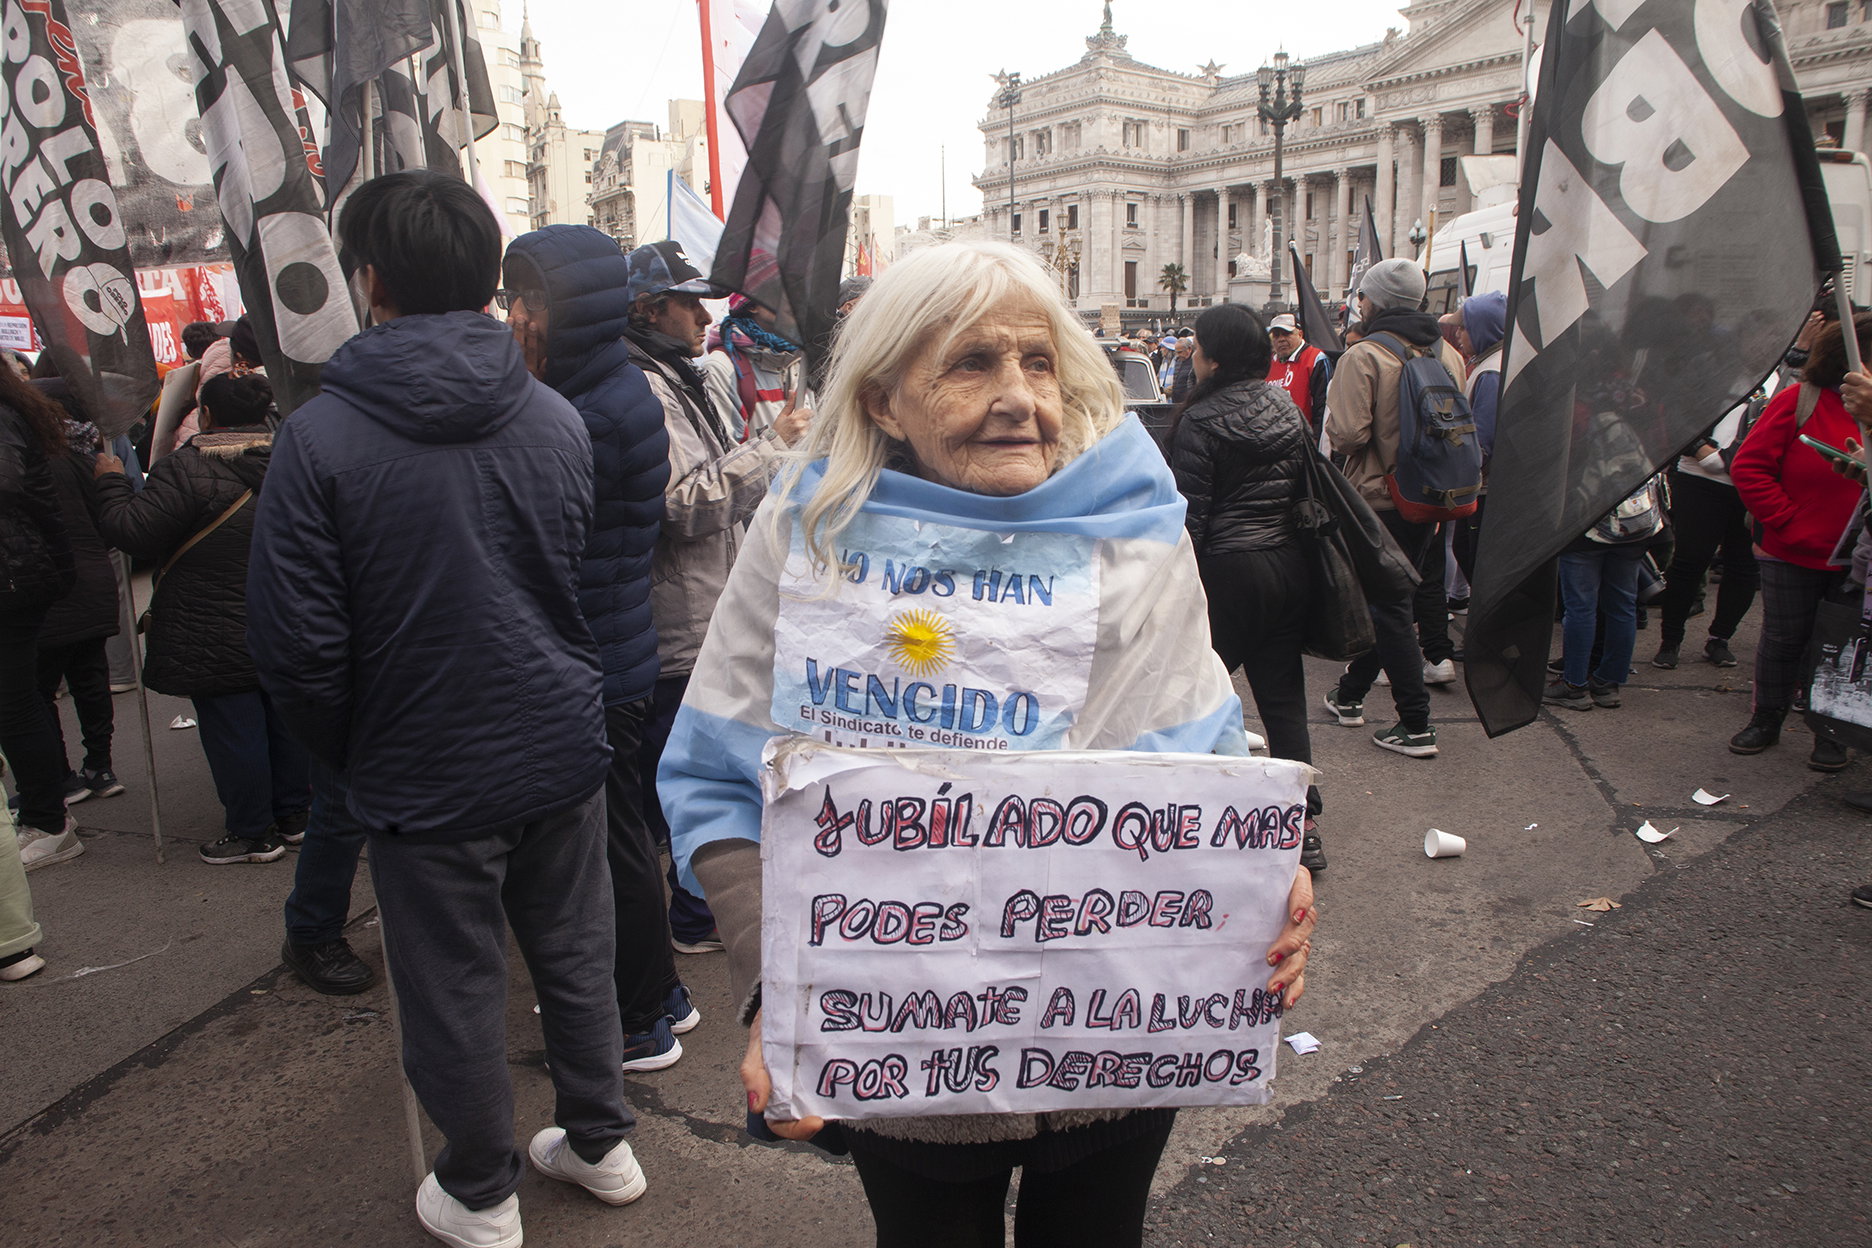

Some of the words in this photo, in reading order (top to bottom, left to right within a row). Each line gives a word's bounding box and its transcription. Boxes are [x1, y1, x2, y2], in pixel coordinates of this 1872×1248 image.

[881, 558, 956, 597] NOS
[972, 565, 1054, 607] HAN
[806, 656, 1040, 737] VENCIDO
[800, 705, 816, 722] El
[821, 710, 902, 736] Sindicato
[908, 724, 925, 740] te
[930, 728, 1008, 750] defiende
[1112, 801, 1202, 862] QUE
[1210, 803, 1304, 851] MAS
[808, 893, 971, 946] PODES
[1000, 888, 1213, 943] PERDER
[1040, 985, 1075, 1030] A
[1085, 988, 1141, 1031] LA
[816, 1053, 910, 1100] POR
[1016, 1047, 1262, 1090] DERECHOS
